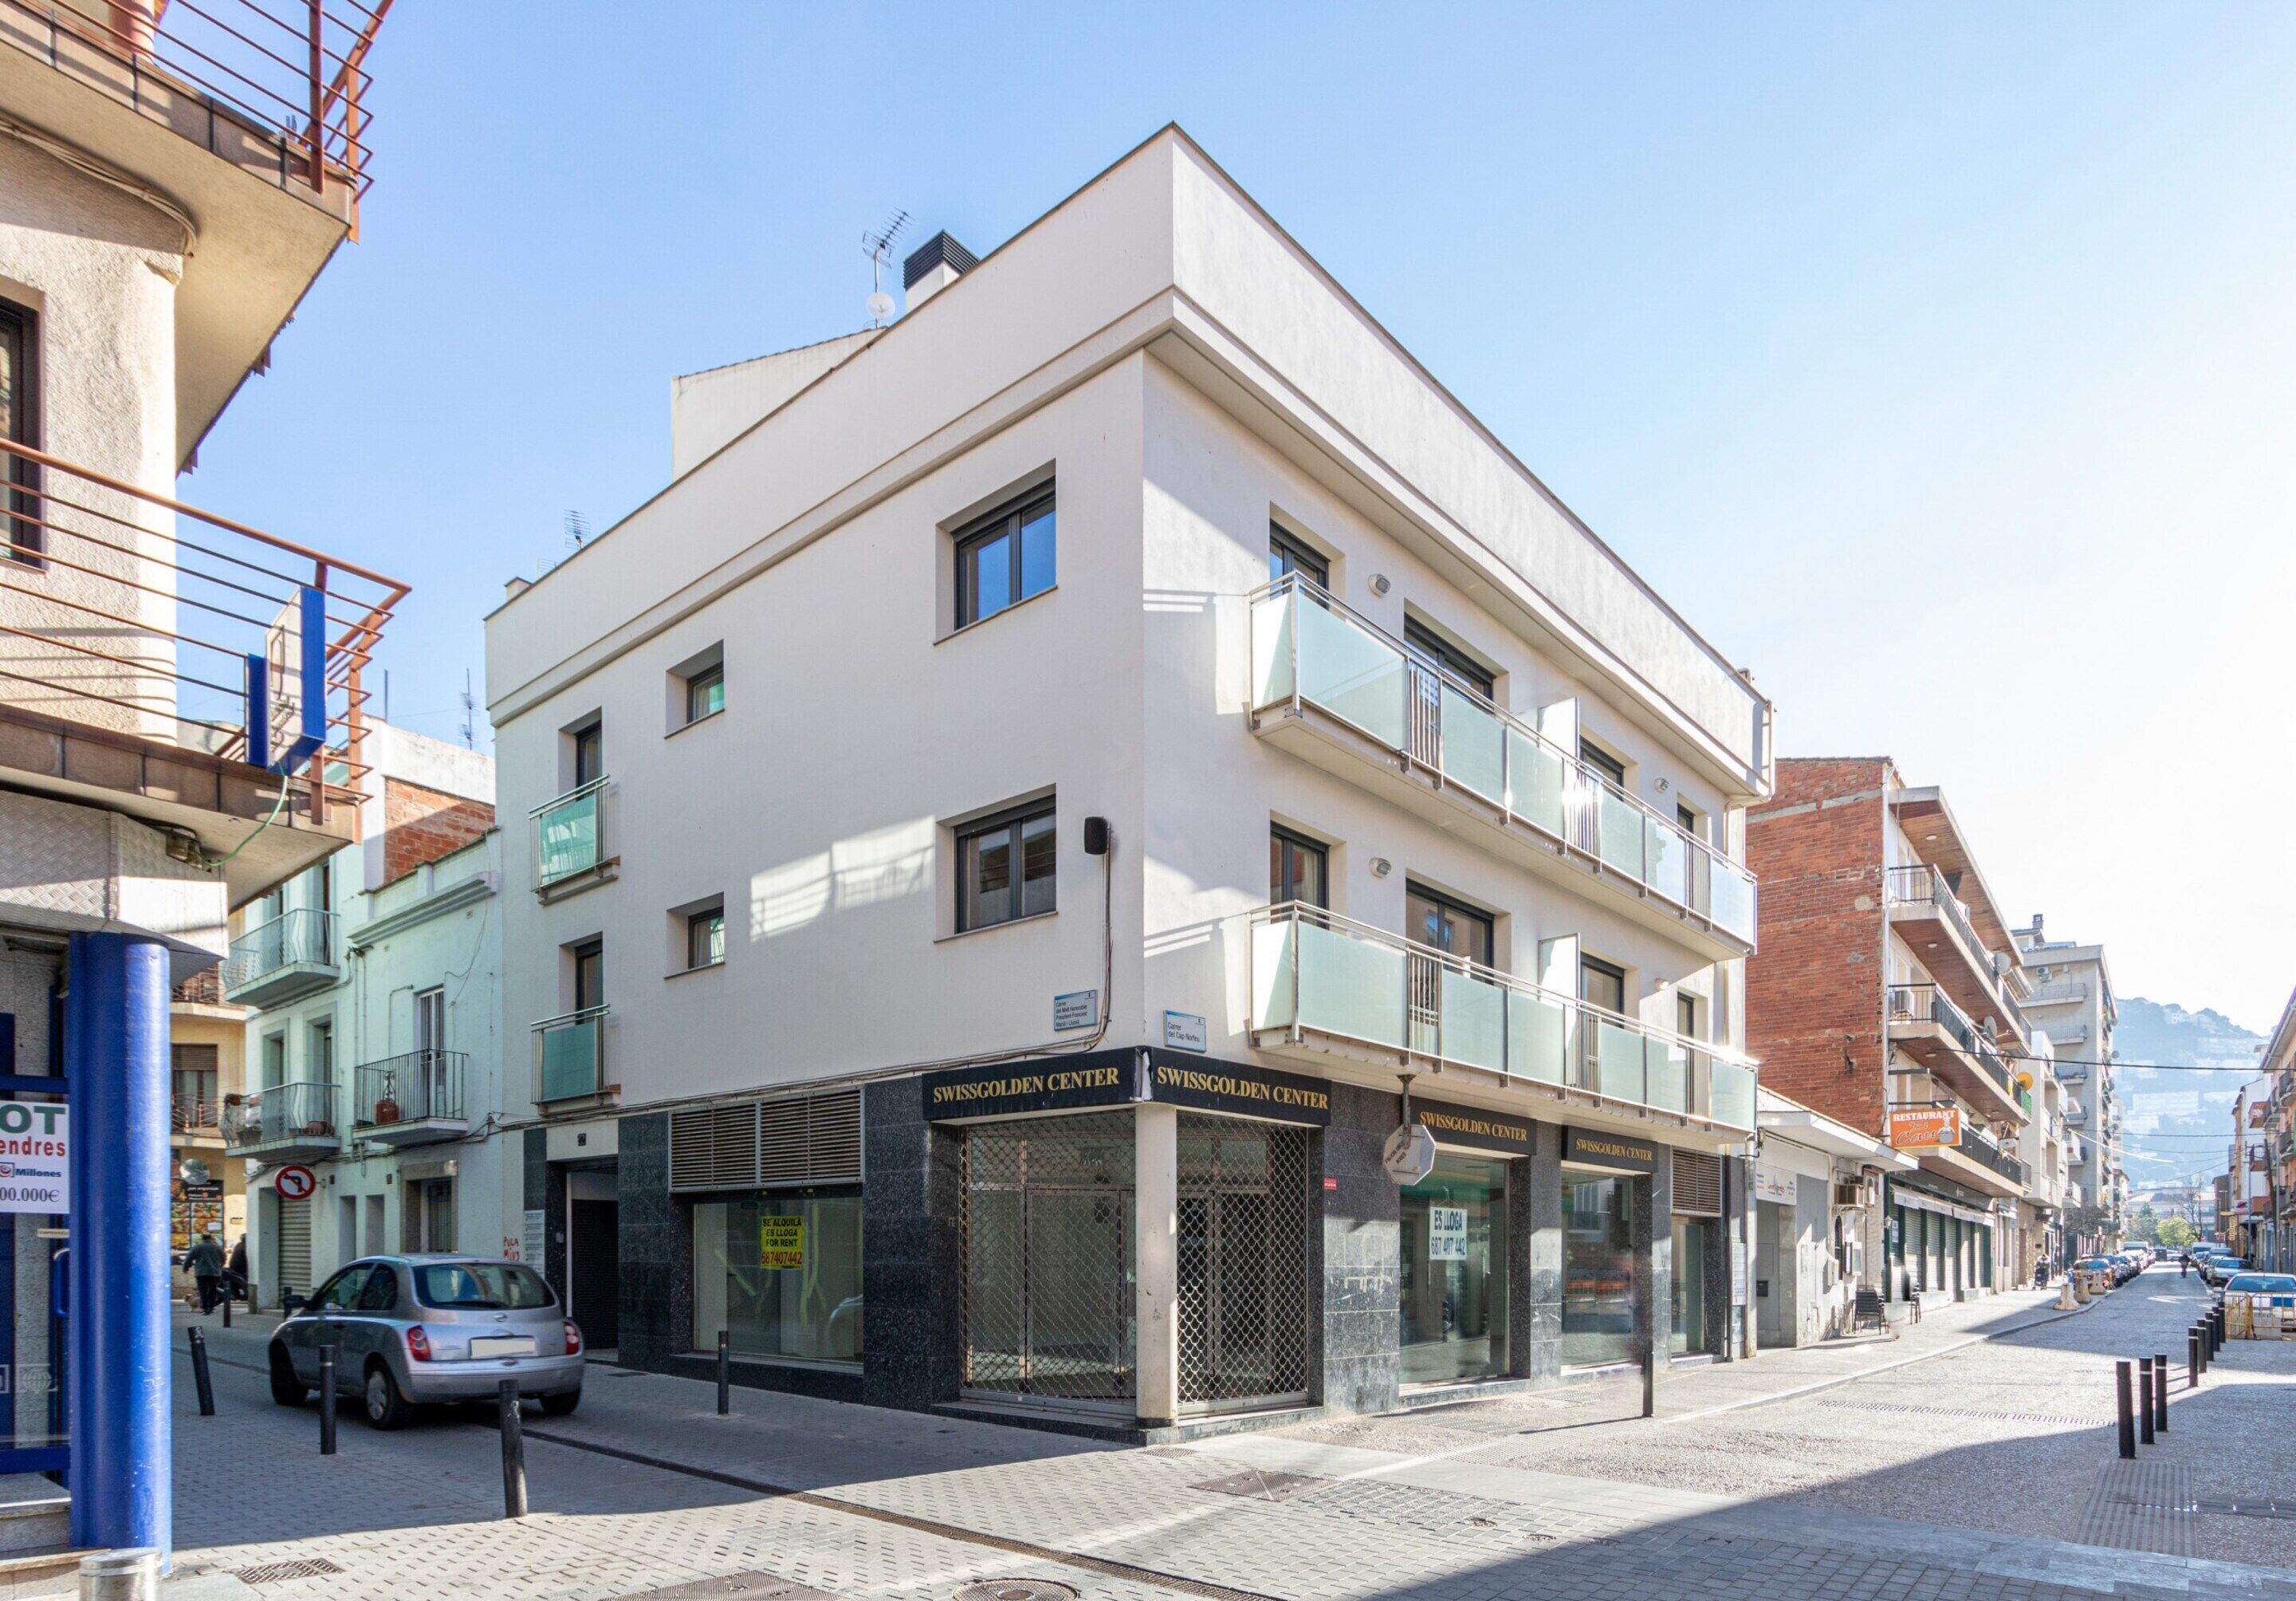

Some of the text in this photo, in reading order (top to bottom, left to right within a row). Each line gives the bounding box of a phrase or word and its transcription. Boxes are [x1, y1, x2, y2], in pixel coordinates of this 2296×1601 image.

[1168, 1021, 1181, 1030] Carrer
[934, 1067, 1120, 1103] SWISSGOLDEN CENTER
[1157, 1066, 1328, 1110] SWISSGOLDEN CENTER
[1893, 1110, 1956, 1122] RESTAURANT
[1420, 1111, 1527, 1141] SWISSGOLDEN CENTER
[1576, 1138, 1653, 1161] SWISSGOLDEN CENTER
[773, 1217, 801, 1226] ALQUILA
[1434, 1210, 1463, 1231] ES LLOGA
[1431, 1237, 1465, 1255] 687 407 442
[761, 1251, 802, 1265] 687407442
